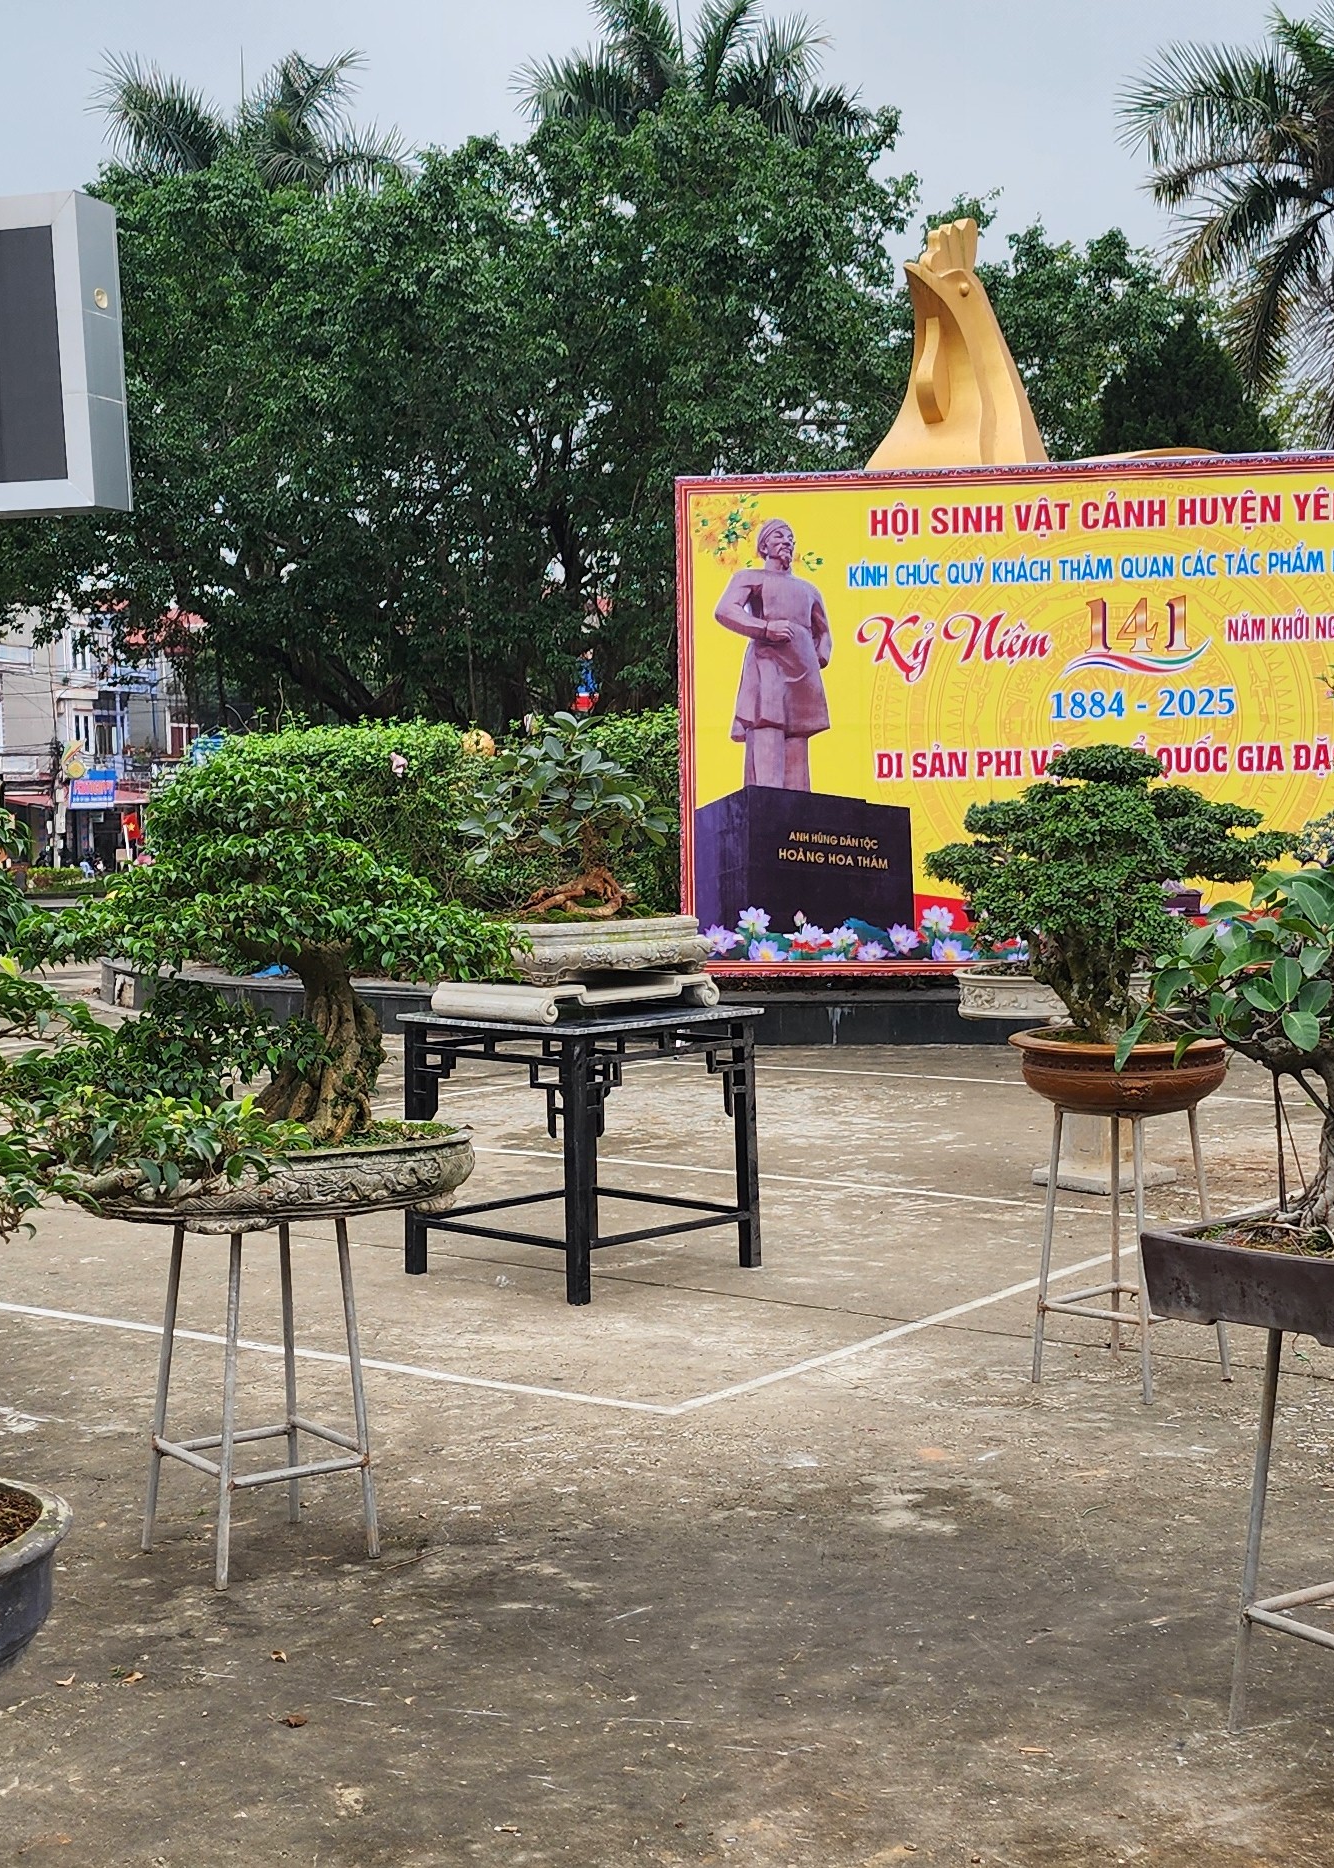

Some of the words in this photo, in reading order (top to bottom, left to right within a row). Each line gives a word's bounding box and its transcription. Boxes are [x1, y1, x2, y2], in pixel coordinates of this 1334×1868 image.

[870, 502, 919, 542] HỘI
[931, 505, 1004, 535] SINH
[1015, 497, 1070, 538] VẬT
[1081, 491, 1166, 531] CẢNH
[1177, 489, 1281, 530] HUYỆN
[847, 559, 888, 587] KÍNH
[896, 557, 940, 586] CHÚC
[947, 556, 984, 586] QUÝ
[992, 554, 1051, 583] KHÁCH
[1059, 554, 1113, 581] THĂM
[1121, 555, 1174, 580] QUAN
[1182, 547, 1216, 577] CÁC
[1225, 547, 1260, 576] TÁC
[1268, 541, 1324, 574] PHẨM
[856, 613, 934, 683] Kỷ
[941, 612, 1051, 666] Niệm
[1085, 595, 1192, 654] 141
[1227, 612, 1265, 642] NĂM
[1271, 607, 1310, 640] KHỞI
[1051, 691, 1125, 719] 1884
[1158, 688, 1235, 717] 2025
[877, 752, 903, 779] DI
[912, 743, 967, 778] SẢN
[976, 750, 1022, 778] PHI
[1156, 735, 1228, 779] QUỐC
[1238, 745, 1284, 773] GIA
[789, 831, 809, 843] ANH
[828, 852, 855, 867] HOA
[857, 854, 889, 870] THÁM
